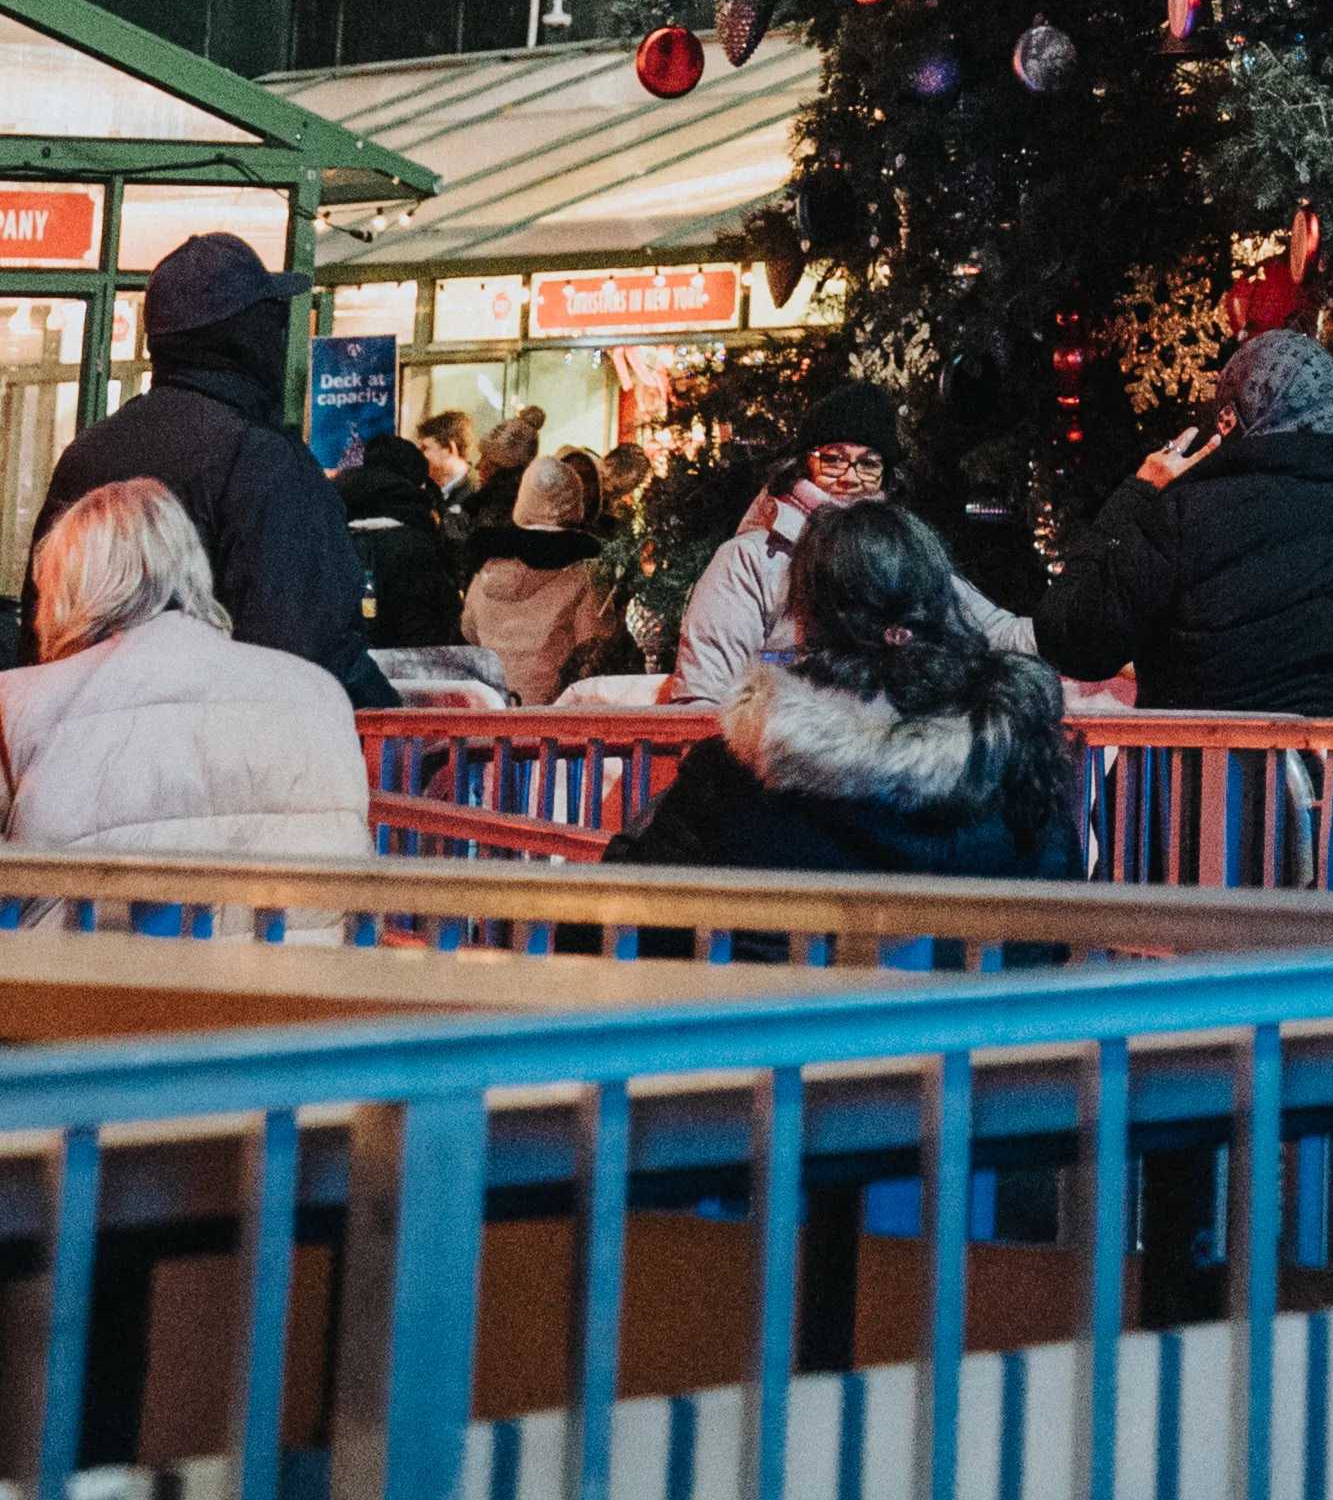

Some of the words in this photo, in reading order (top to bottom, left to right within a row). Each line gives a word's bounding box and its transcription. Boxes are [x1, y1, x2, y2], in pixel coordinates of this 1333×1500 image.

[0, 209, 49, 241] ANY
[320, 372, 362, 389] Deck
[368, 373, 386, 387] at
[317, 388, 388, 408] capacity
